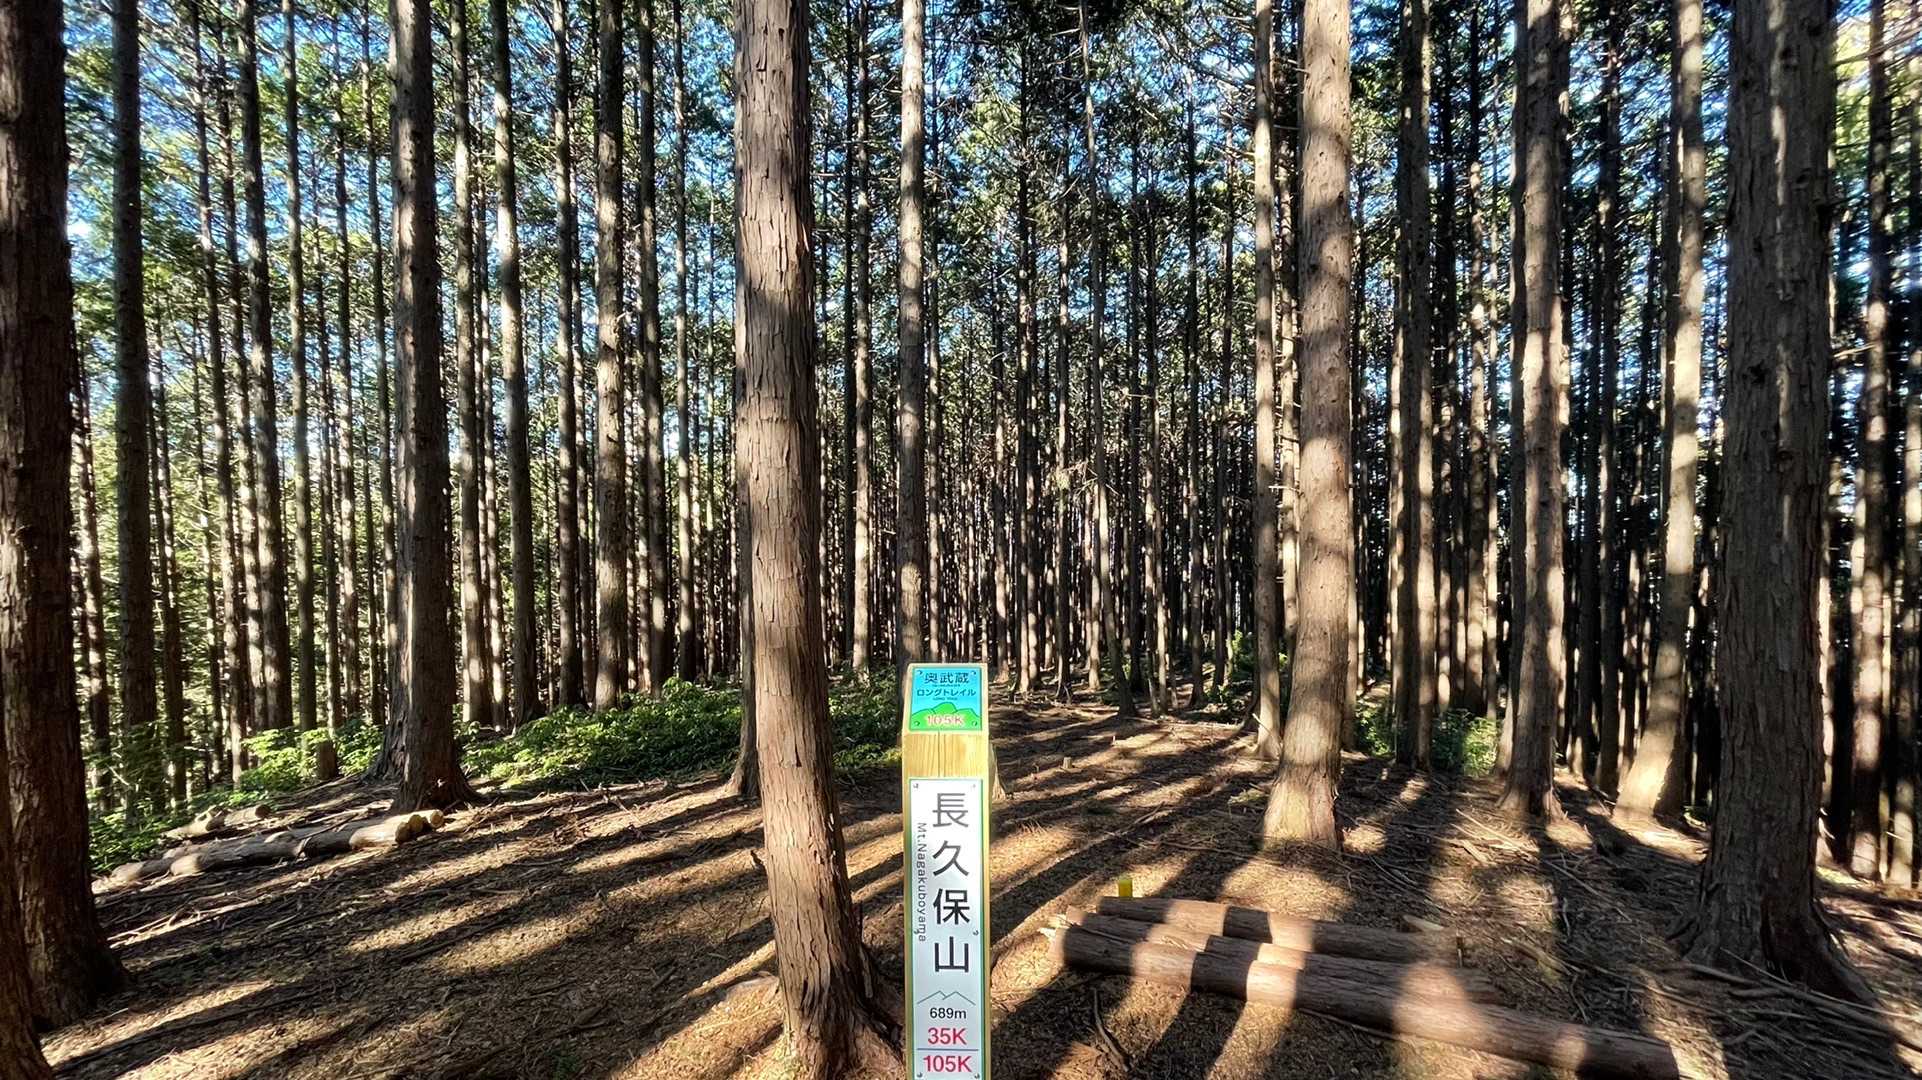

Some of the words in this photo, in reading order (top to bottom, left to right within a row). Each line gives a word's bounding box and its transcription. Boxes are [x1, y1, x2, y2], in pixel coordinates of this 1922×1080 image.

[924, 672, 969, 684] 奥武蔵
[916, 689, 977, 697] ロングトレイル
[927, 715, 963, 725] 105K
[932, 793, 970, 973] 長久保山
[930, 1007, 967, 1019] 689m
[928, 1027, 967, 1045] 35K
[923, 1055, 972, 1073] 105K
